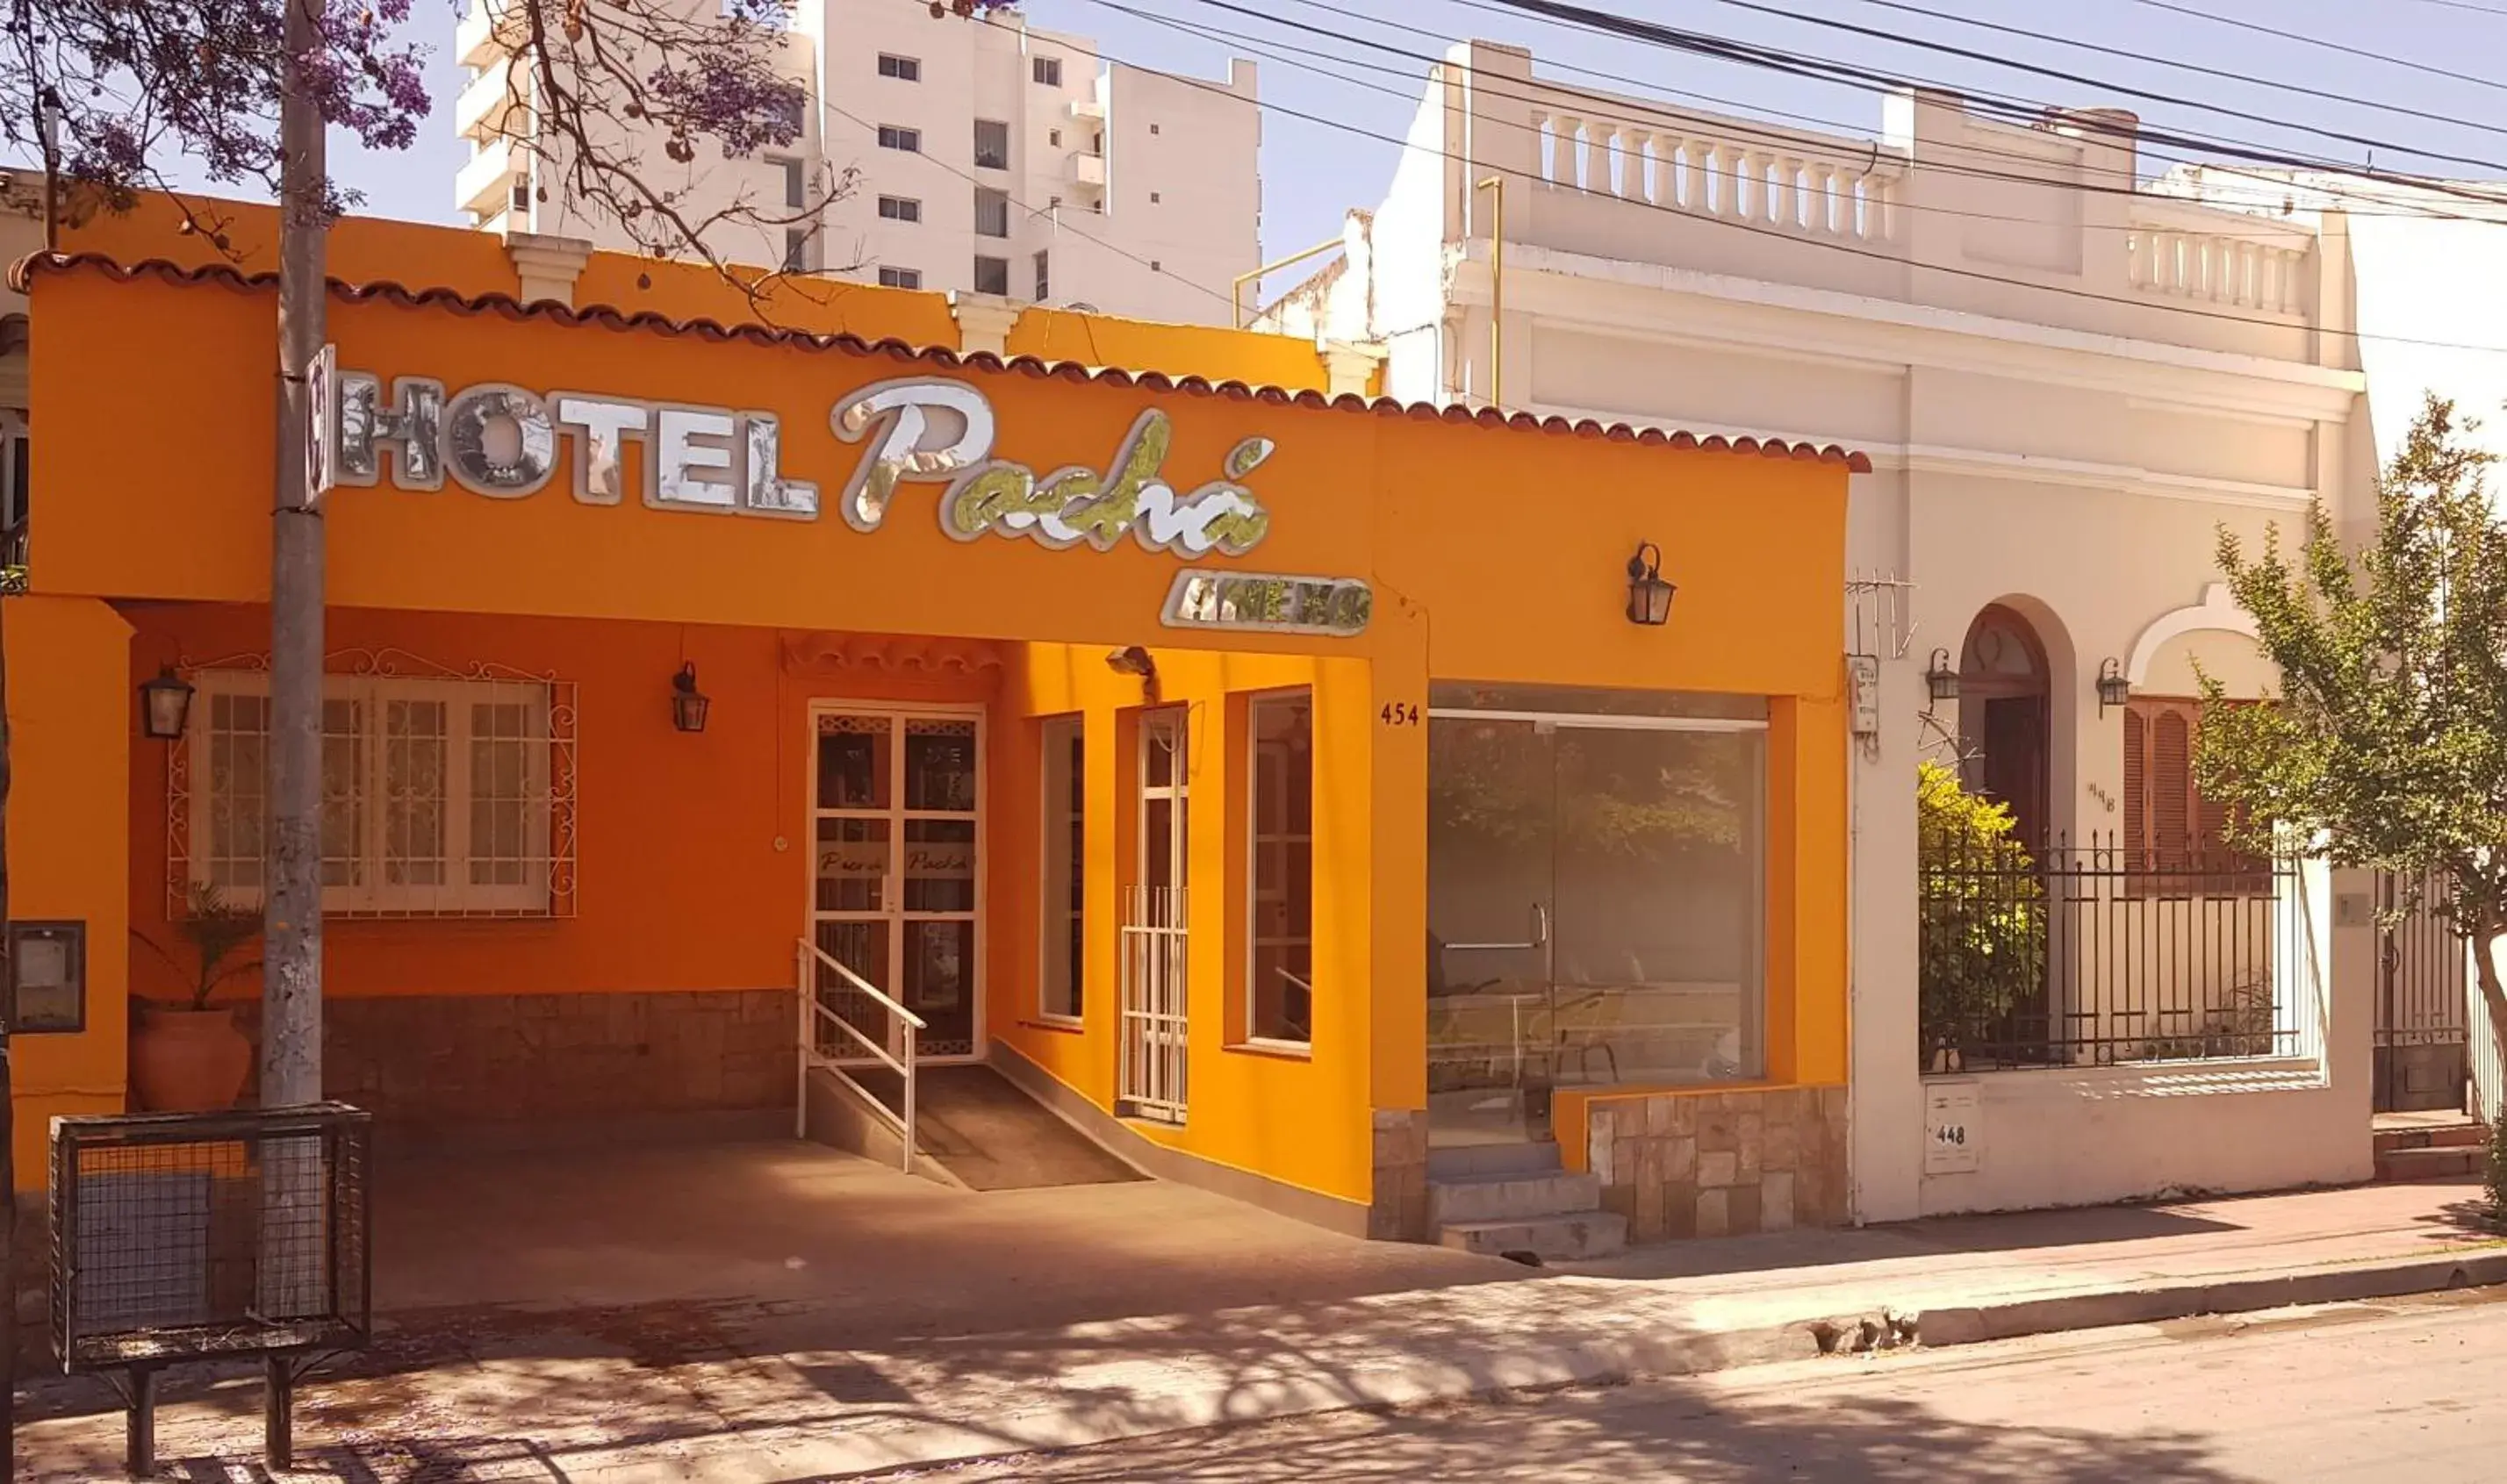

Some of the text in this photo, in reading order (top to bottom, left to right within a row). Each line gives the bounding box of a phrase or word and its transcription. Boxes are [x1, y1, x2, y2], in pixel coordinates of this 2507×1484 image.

[340, 376, 818, 514] HOTEL
[1175, 577, 1373, 629] ANEXO
[1381, 702, 1419, 727] 454
[2087, 781, 2116, 813] 448
[1936, 1124, 1965, 1145] 448
